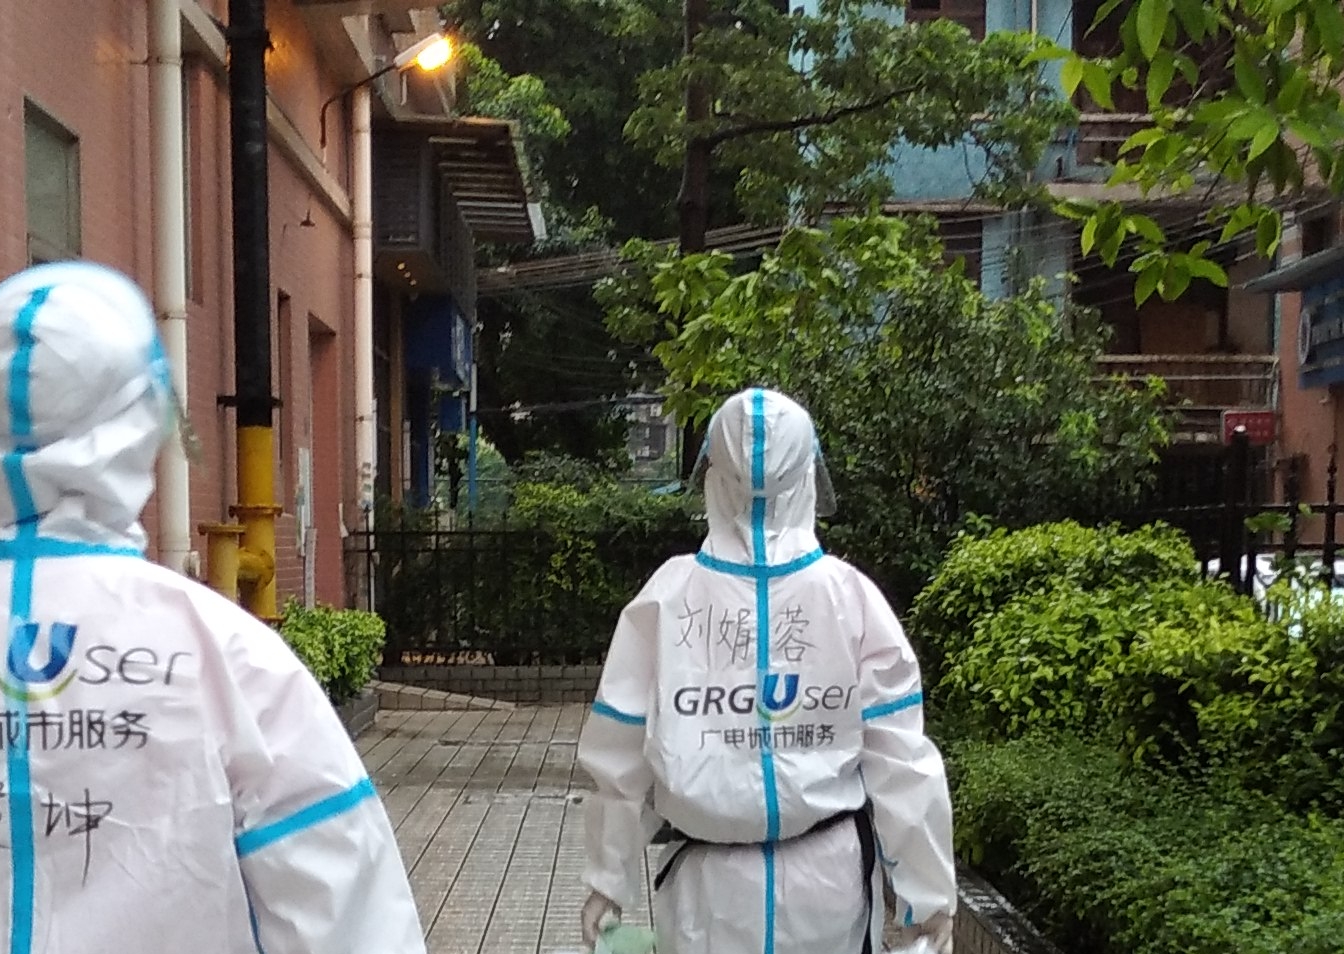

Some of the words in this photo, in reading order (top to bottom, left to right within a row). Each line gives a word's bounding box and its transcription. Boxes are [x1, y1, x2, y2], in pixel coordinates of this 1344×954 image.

[698, 722, 836, 751] 广电城市服务
